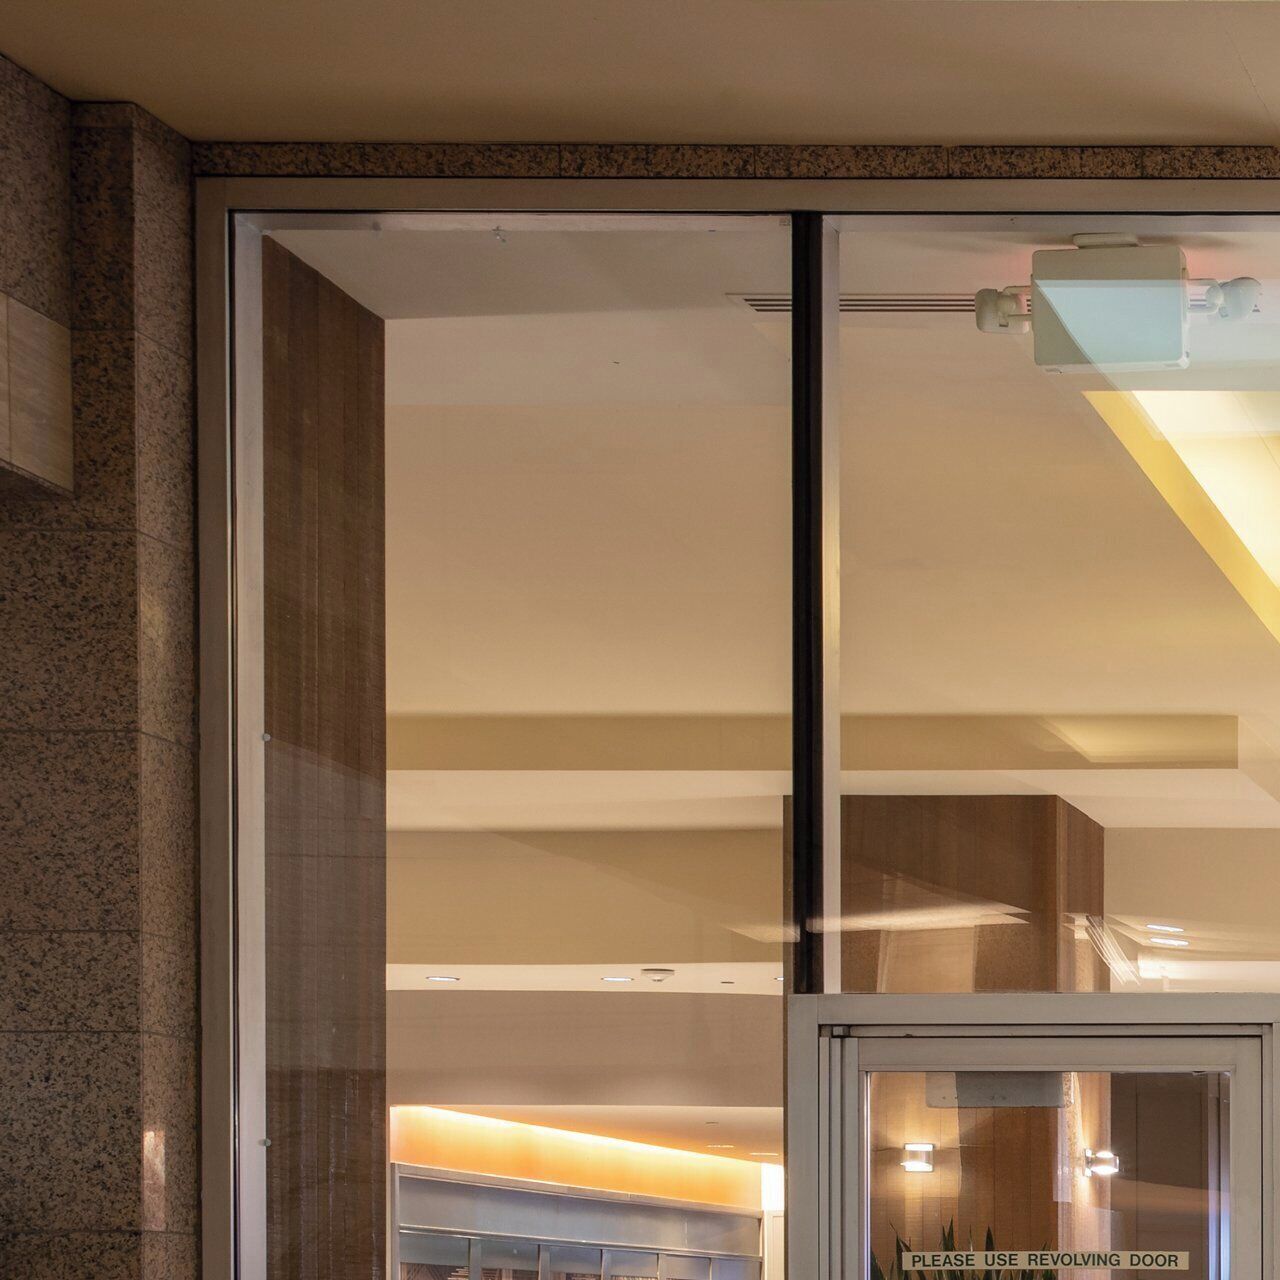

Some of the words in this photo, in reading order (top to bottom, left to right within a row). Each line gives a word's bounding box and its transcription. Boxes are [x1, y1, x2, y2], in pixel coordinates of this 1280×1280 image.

[911, 1254, 976, 1267] PLEASE
[984, 1253, 1019, 1266] USE
[1028, 1253, 1121, 1267] REVOLVING
[1129, 1253, 1179, 1267] DOOR
